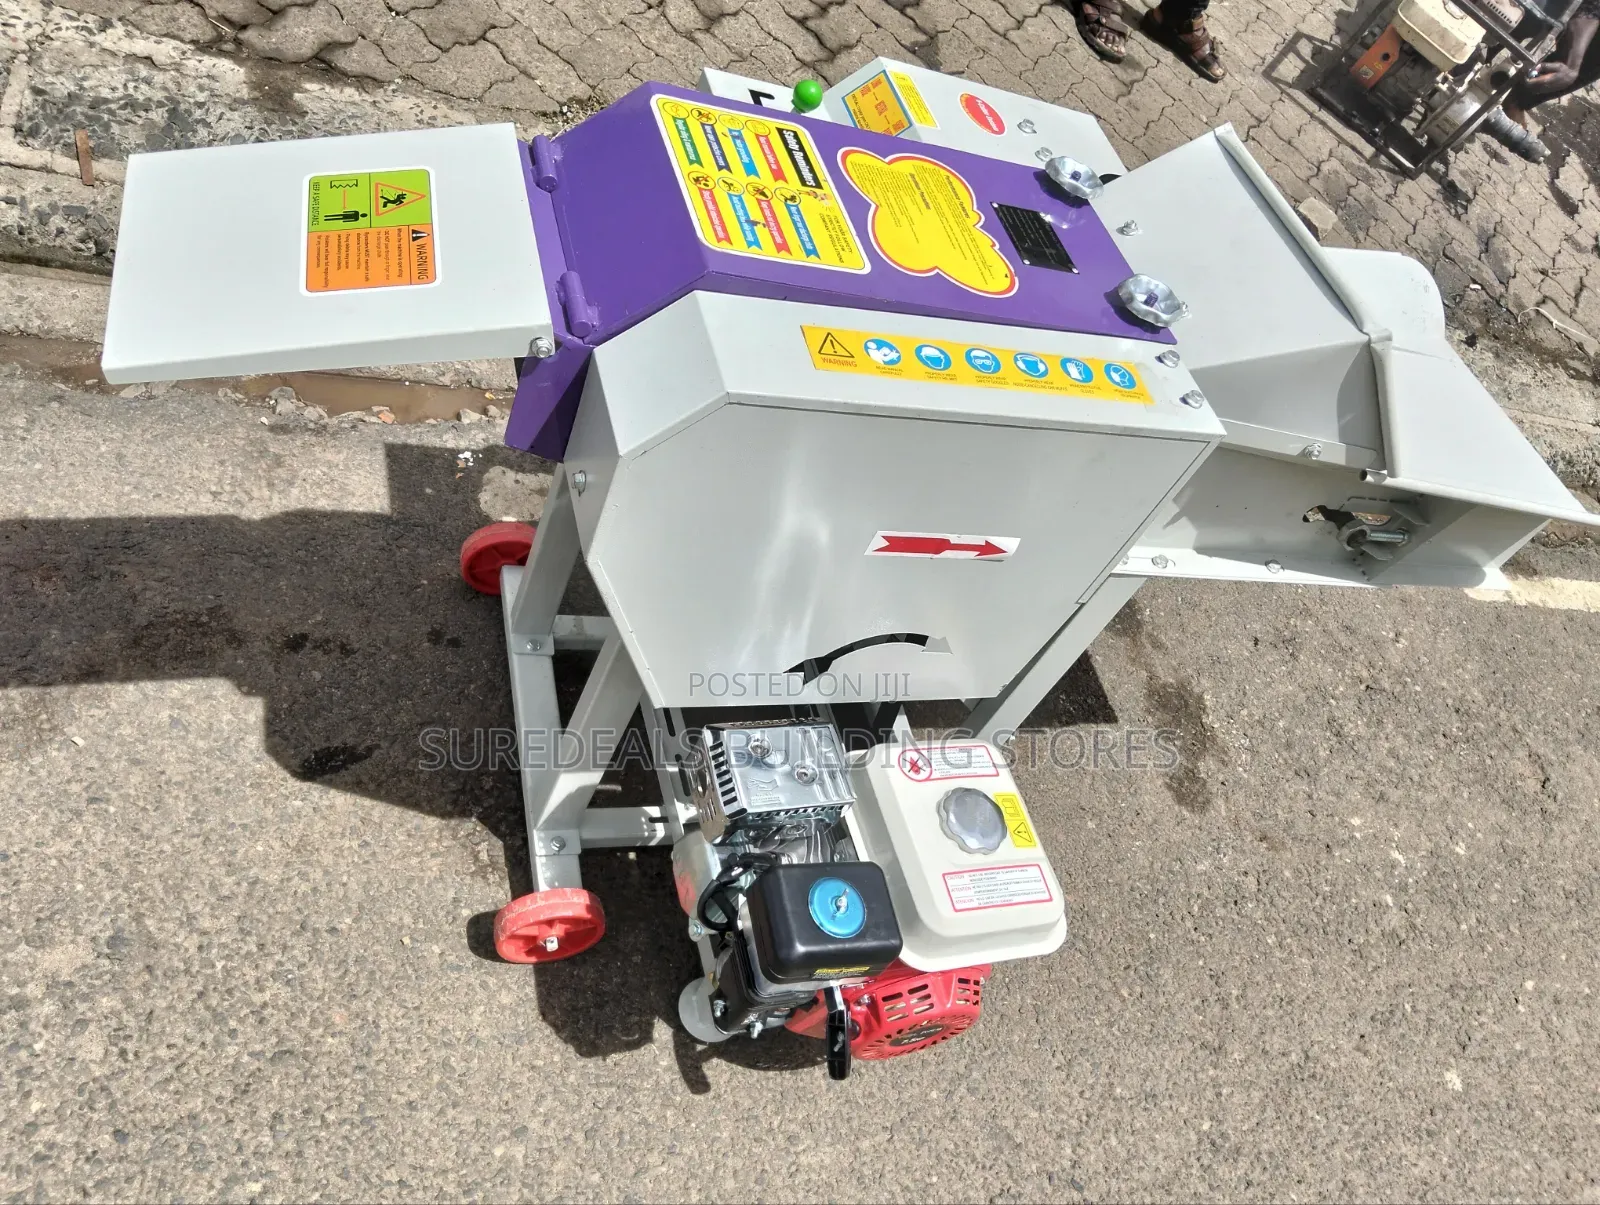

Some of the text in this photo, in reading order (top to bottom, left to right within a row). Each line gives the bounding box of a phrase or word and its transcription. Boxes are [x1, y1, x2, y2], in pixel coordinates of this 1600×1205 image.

[782, 130, 816, 186] Safety Reminders
[312, 181, 320, 191] KEEP
[311, 195, 319, 205] SAFE
[311, 206, 319, 226] DISTANCE
[415, 243, 428, 280] WARNING
[820, 356, 858, 368] WARNING
